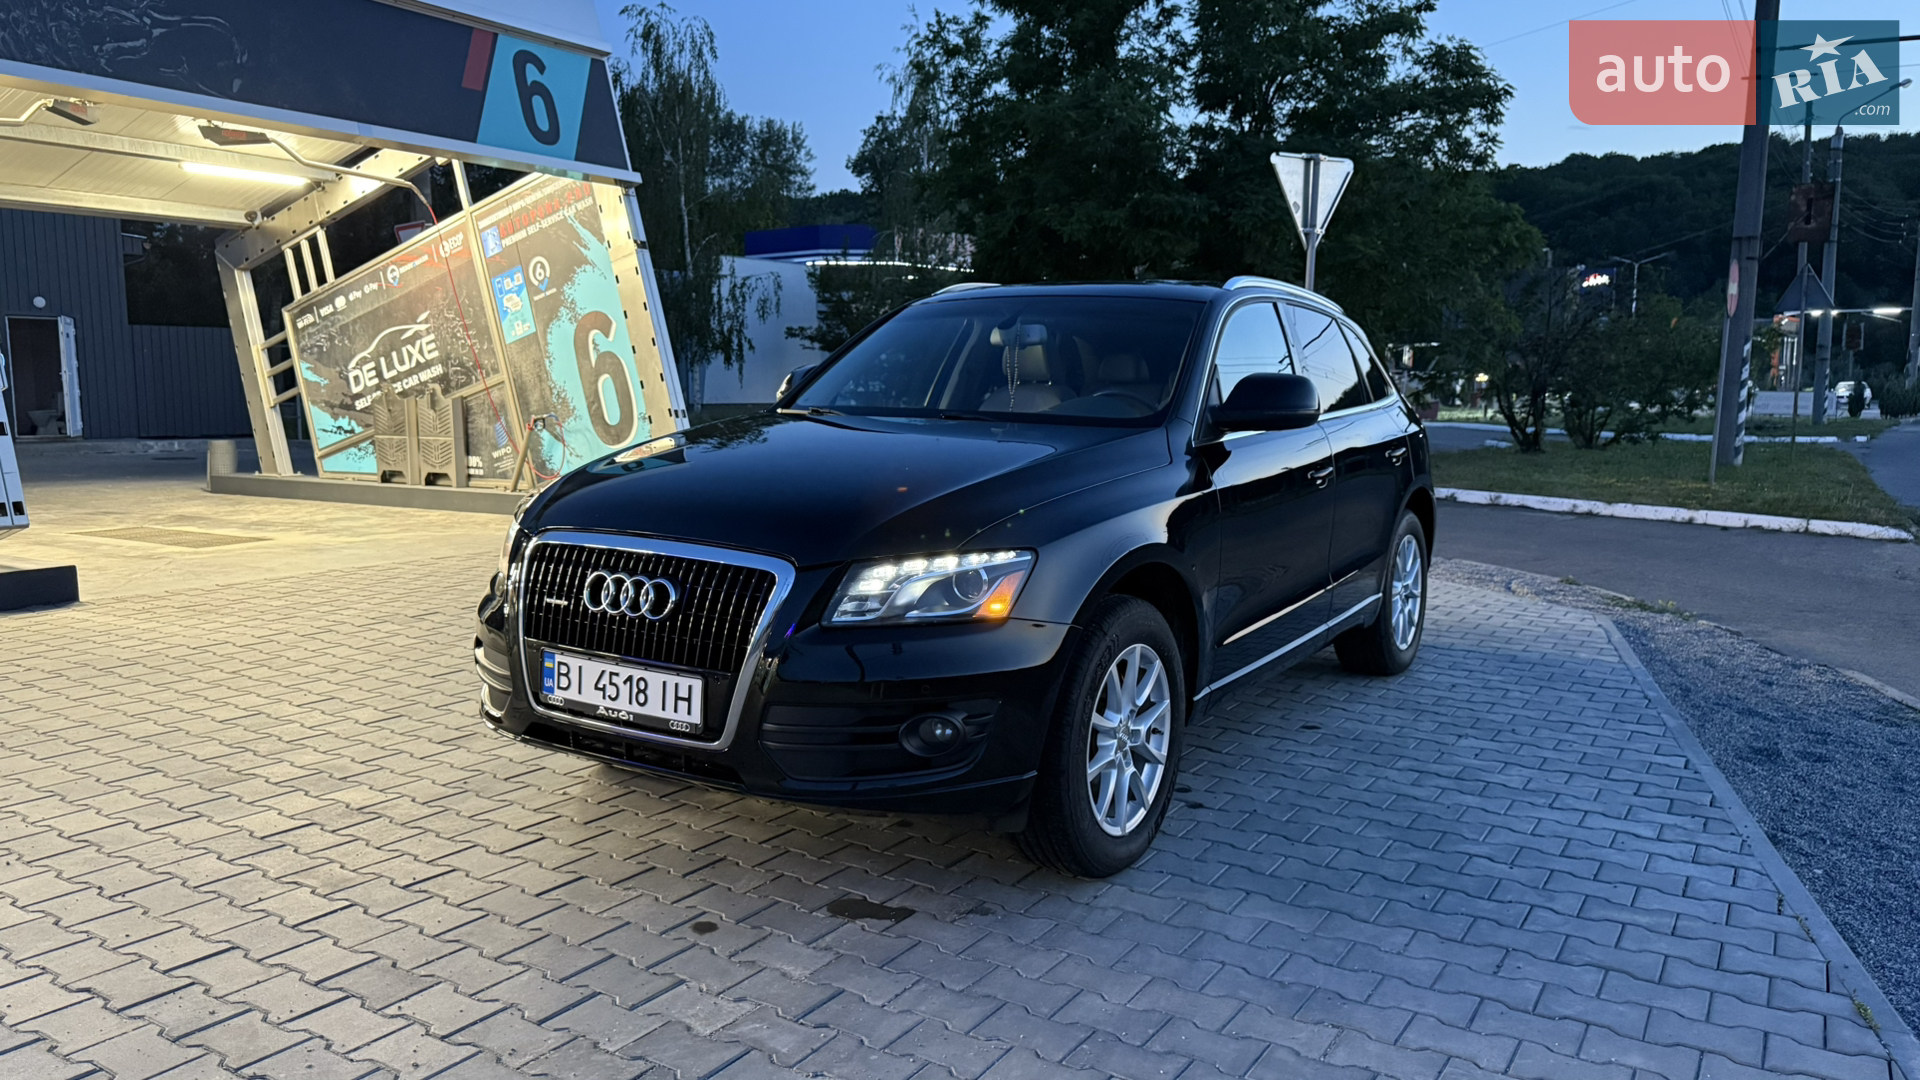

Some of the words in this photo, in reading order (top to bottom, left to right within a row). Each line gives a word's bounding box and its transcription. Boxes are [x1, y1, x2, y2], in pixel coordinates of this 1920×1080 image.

[512, 49, 561, 146] 6
[535, 263, 545, 281] 6
[348, 361, 379, 394] DE
[380, 333, 440, 380] LUXE
[402, 375, 420, 390] CAR
[418, 363, 444, 383] WASH
[574, 310, 638, 448] 6
[491, 446, 512, 459] WIPO
[544, 677, 554, 688] UA
[557, 660, 582, 695] BI
[594, 669, 648, 707] 4518
[661, 680, 692, 716] IH
